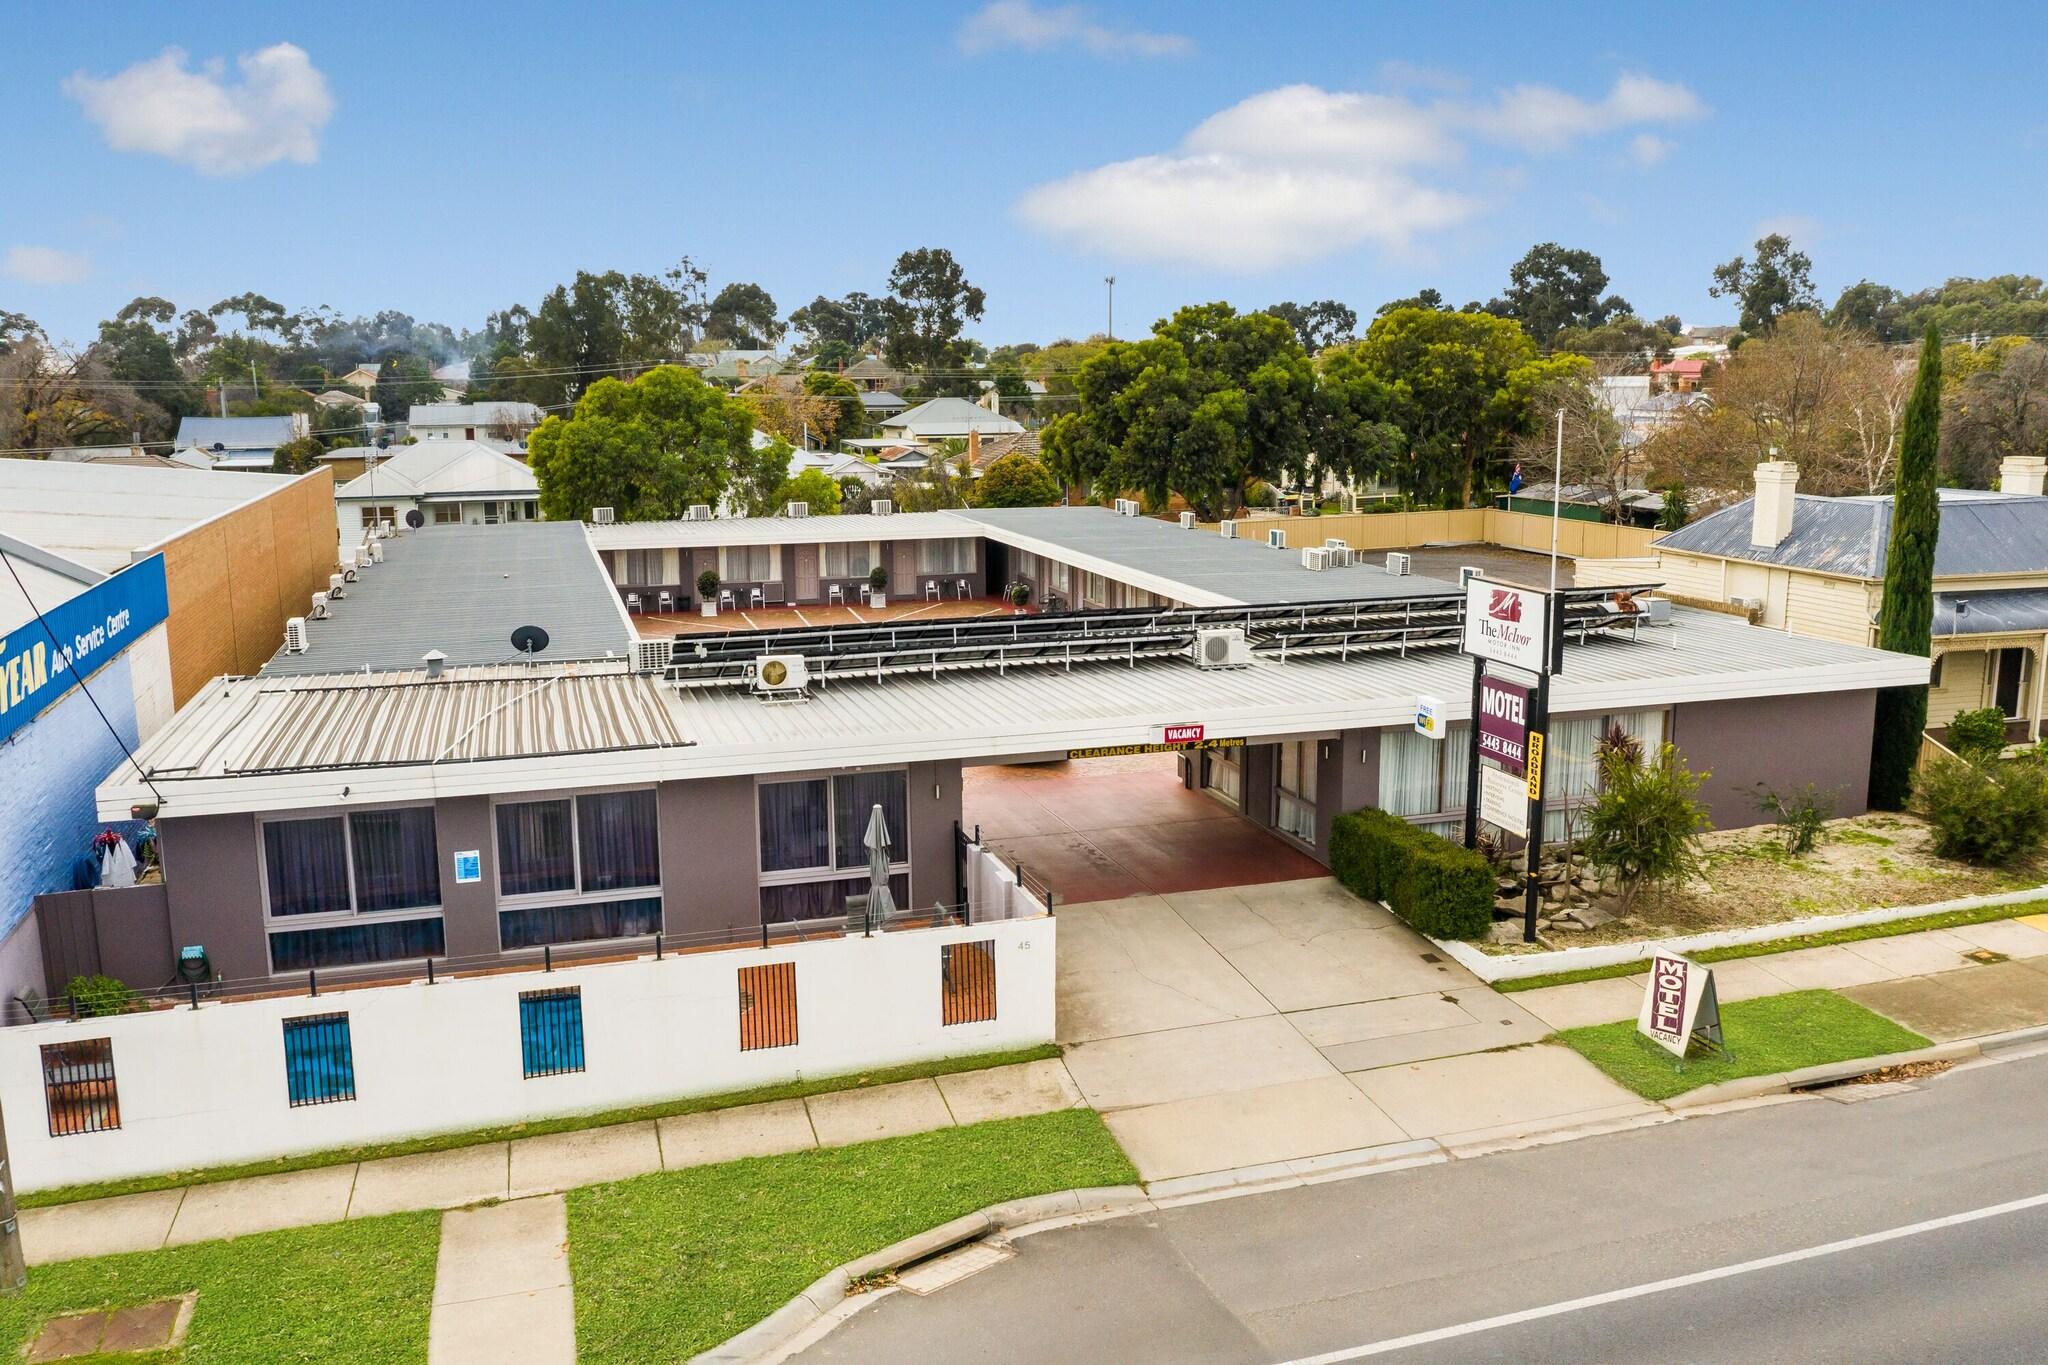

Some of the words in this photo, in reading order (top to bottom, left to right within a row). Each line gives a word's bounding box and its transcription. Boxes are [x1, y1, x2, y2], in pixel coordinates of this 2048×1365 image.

[51, 644, 73, 678] Auto
[75, 625, 105, 660] Service
[107, 608, 130, 639] Centre
[1479, 619, 1497, 638] The
[1497, 624, 1532, 646] McIvor
[1488, 639, 1507, 648] MOTOR
[1509, 643, 1521, 652] INN
[1420, 704, 1433, 715] FREE
[1482, 686, 1525, 726] MOTEL
[1168, 727, 1202, 740] VACANCY
[1070, 745, 1141, 759] CLEARANCE
[1144, 742, 1188, 753] HEIGHT
[1194, 740, 1218, 749] 2.4
[1219, 738, 1245, 748] Metres
[1482, 733, 1500, 751] 5443
[1502, 741, 1522, 759] 8444
[1530, 735, 1540, 795] BROADBAND
[1017, 941, 1031, 950] 45
[1656, 960, 1682, 1034] MOTEL
[1650, 1030, 1682, 1044] VACANCY
